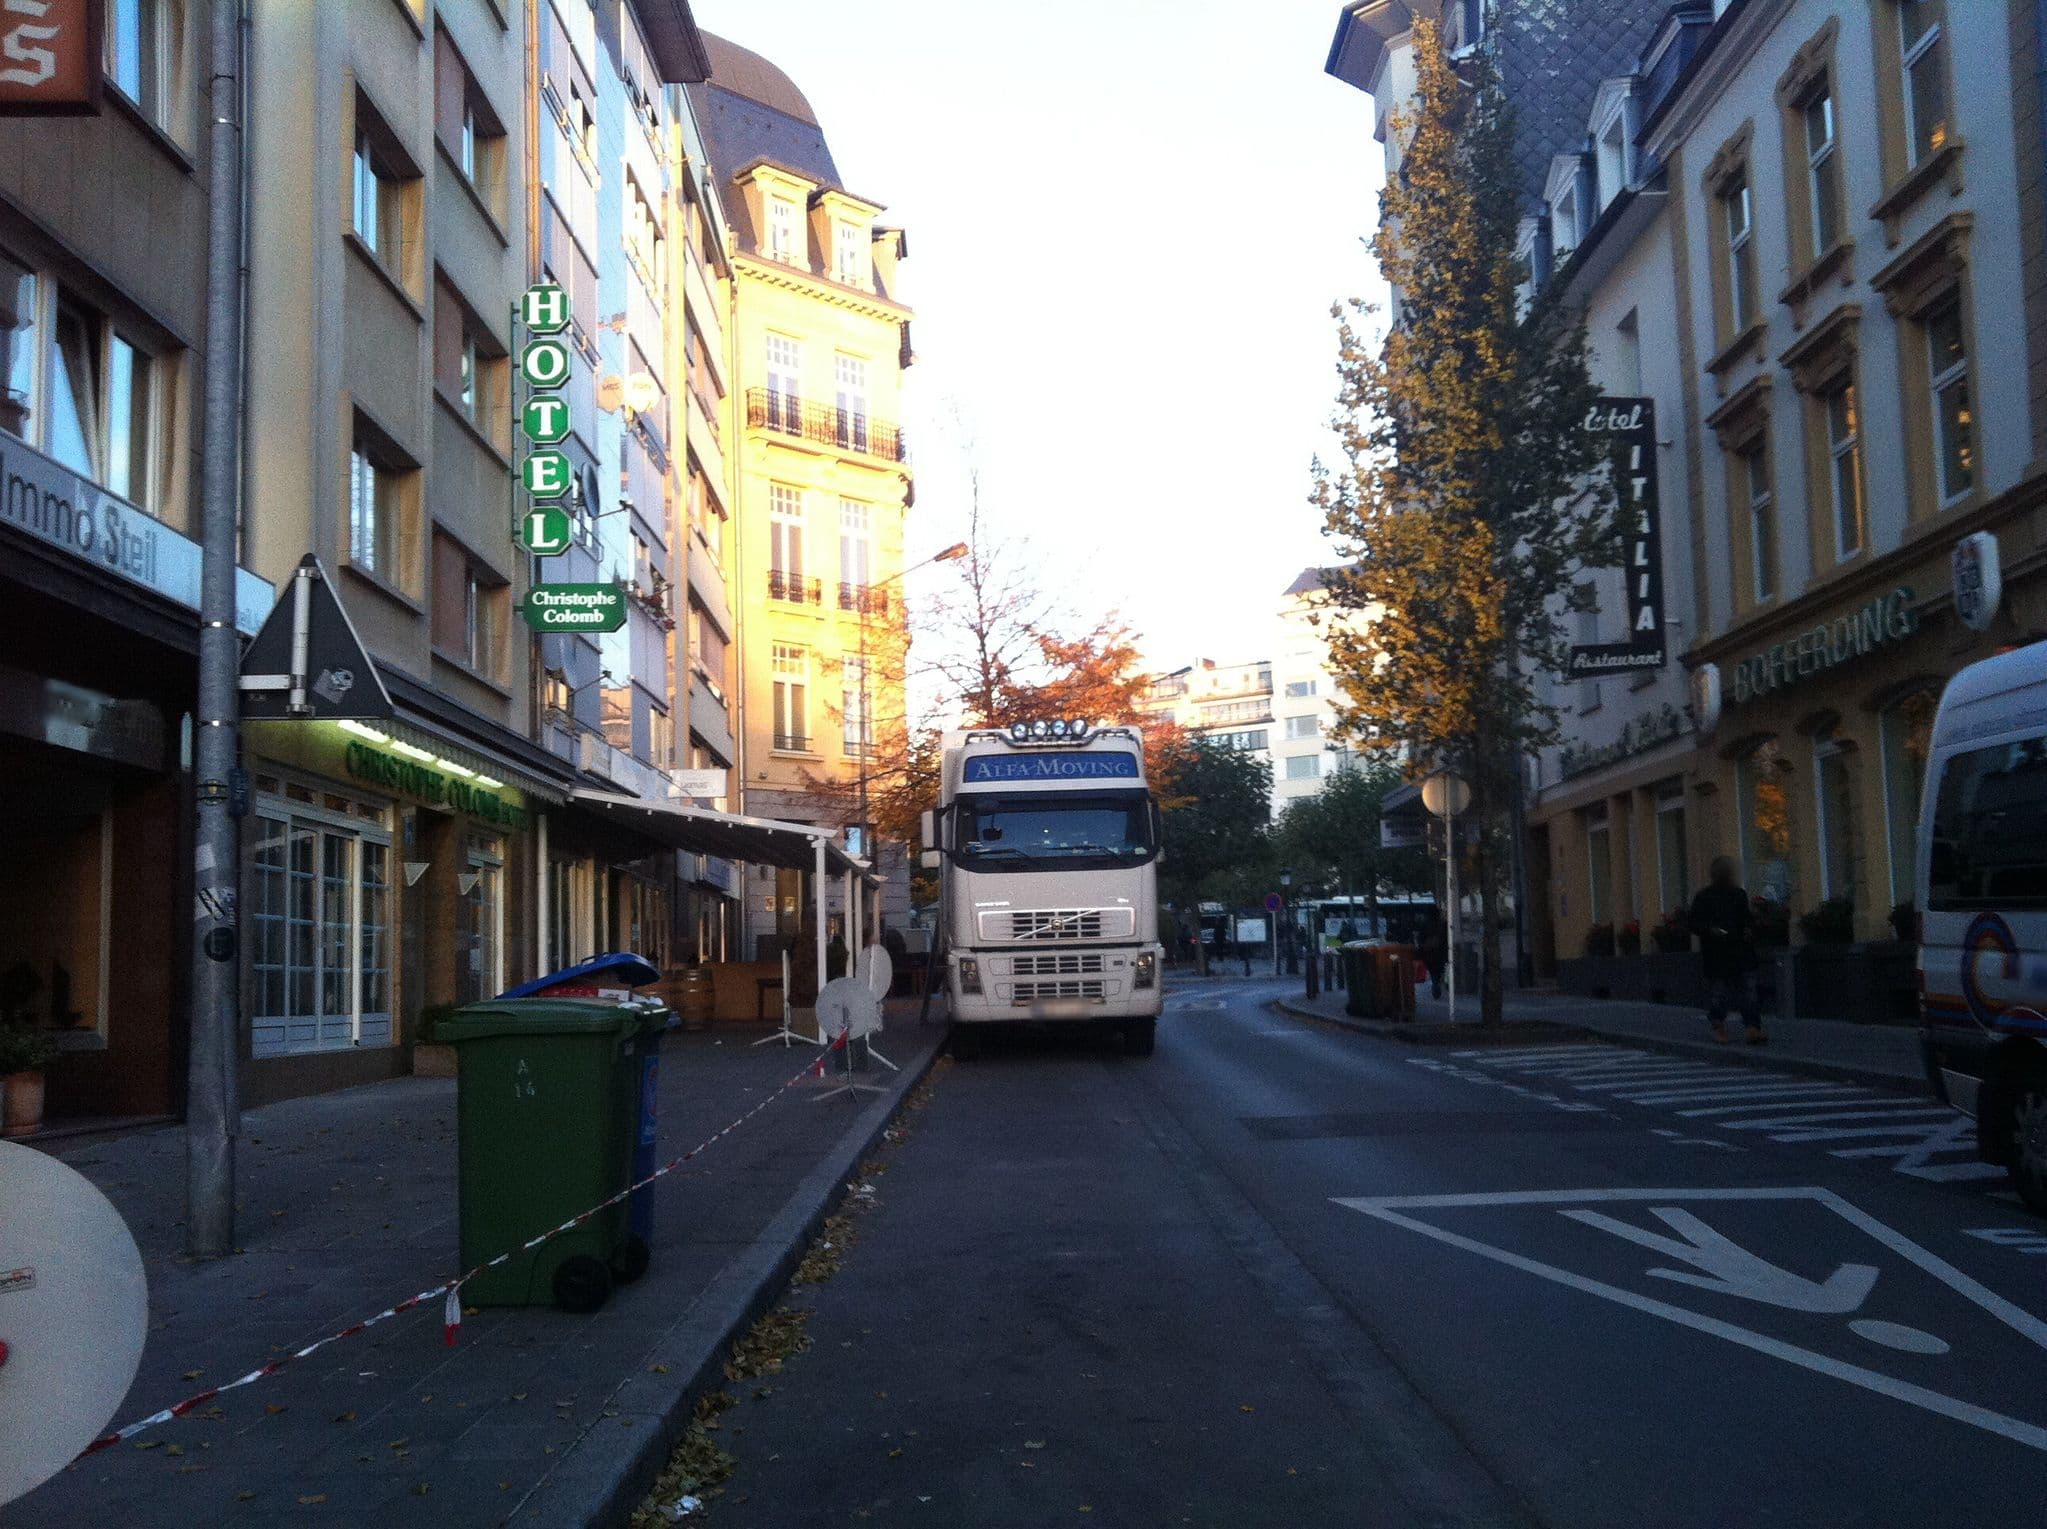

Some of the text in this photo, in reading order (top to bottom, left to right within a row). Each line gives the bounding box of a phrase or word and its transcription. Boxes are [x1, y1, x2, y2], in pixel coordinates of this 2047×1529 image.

[526, 291, 563, 548] HOTEL
[532, 591, 617, 608] Christophe
[543, 609, 605, 623] Colomb
[1735, 586, 1918, 702] BOFFERDING
[1573, 650, 1662, 668] Restaurant
